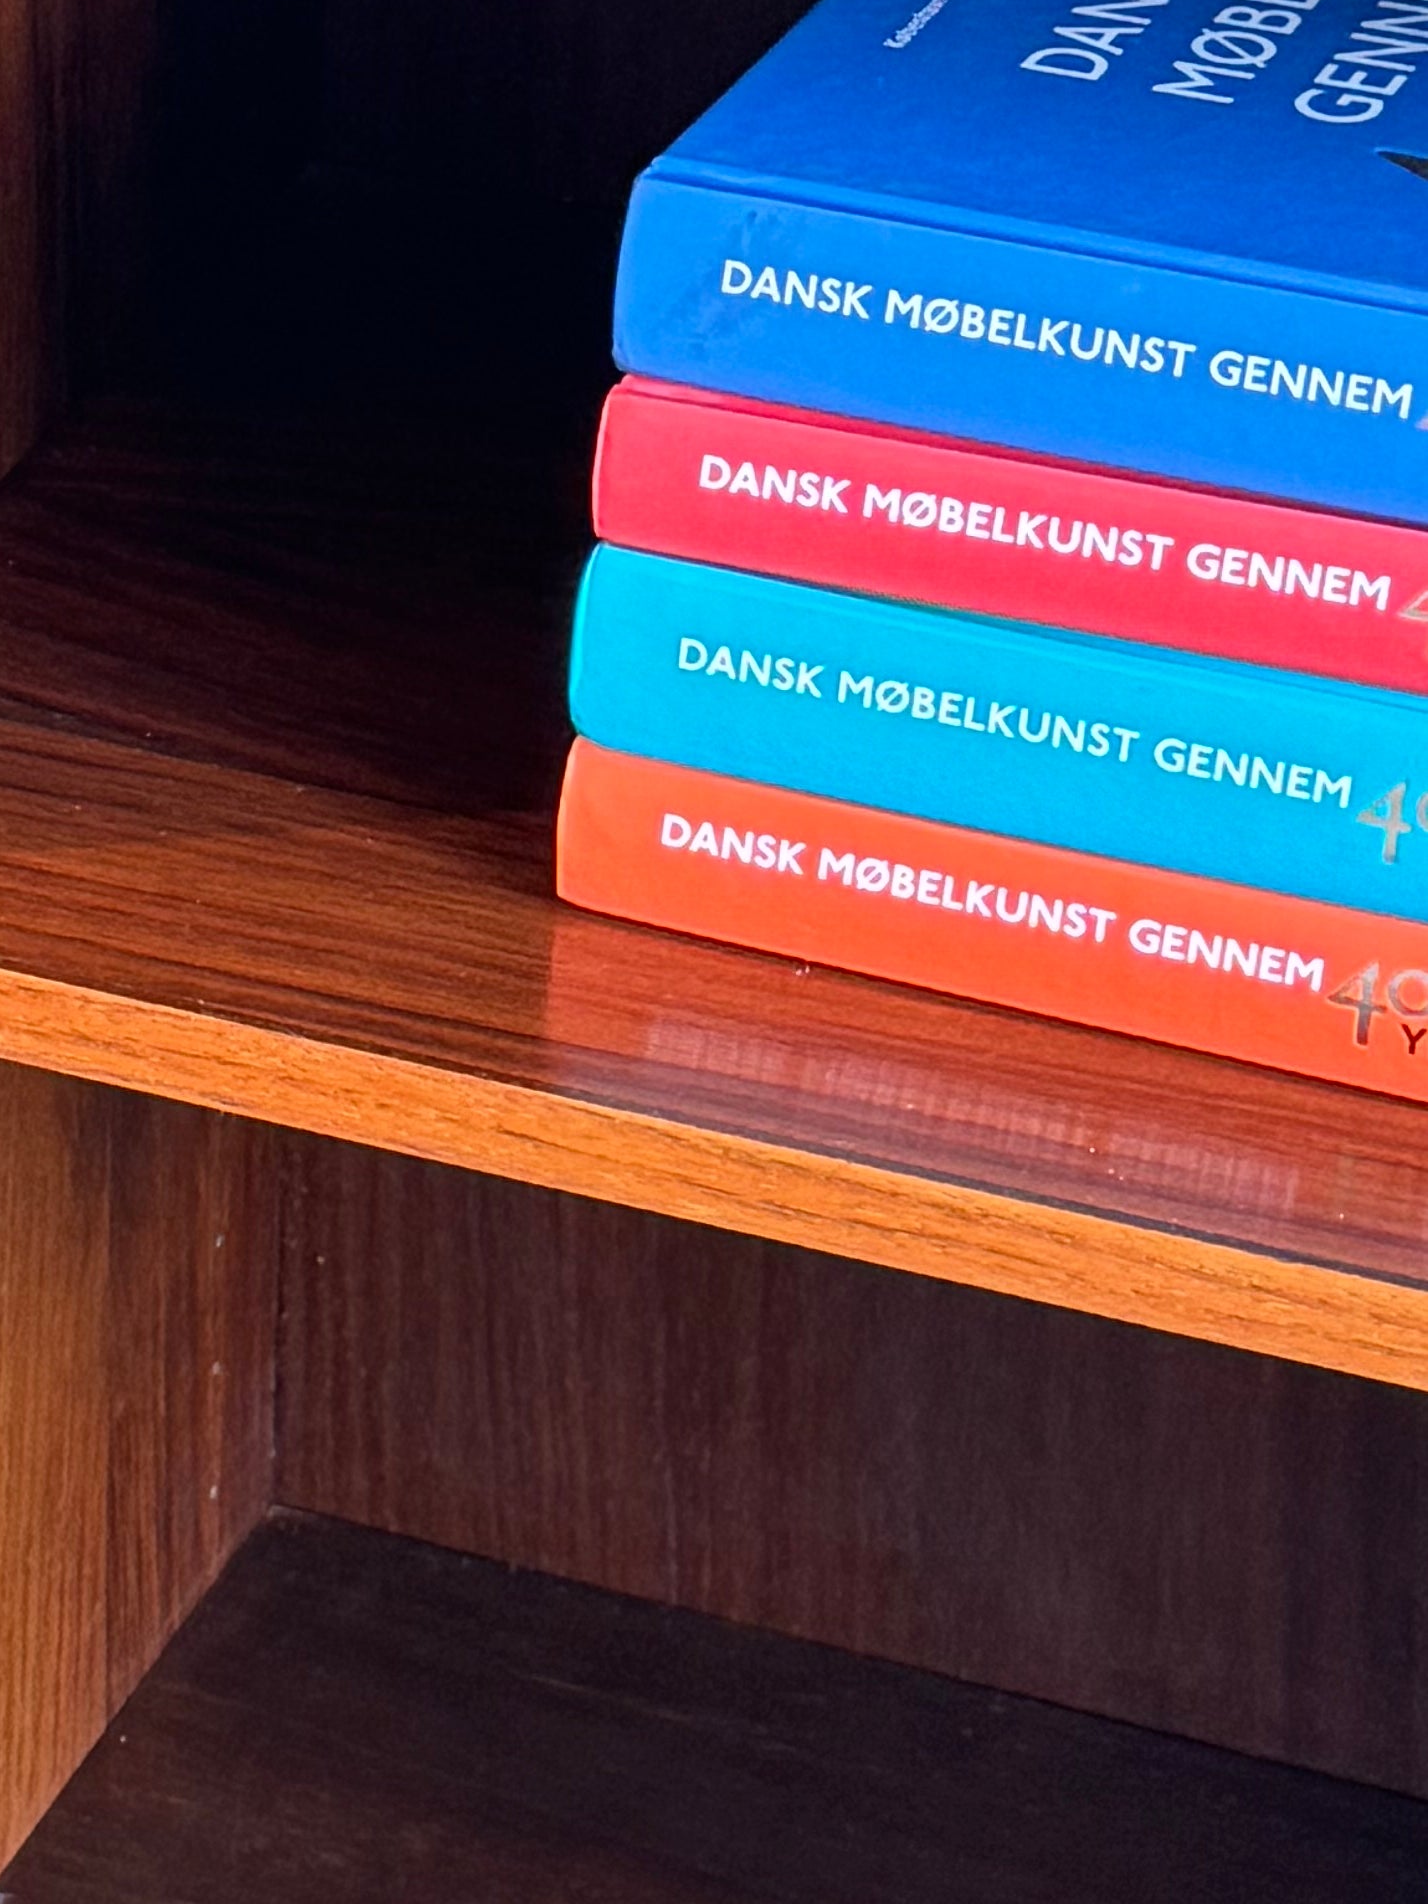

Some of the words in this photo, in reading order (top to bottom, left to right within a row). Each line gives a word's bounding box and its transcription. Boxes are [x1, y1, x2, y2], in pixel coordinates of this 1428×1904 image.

[721, 259, 871, 319] DANSK
[884, 289, 1196, 378] MØBELKUNST
[1209, 350, 1412, 419] GENNEM
[699, 454, 850, 513] DANSK
[862, 483, 1174, 571] MØBELKUNST
[1186, 543, 1391, 611] GENNEM
[677, 637, 823, 698] DANSK
[837, 670, 1140, 762] MØBELKUNST
[1153, 737, 1352, 809] GENNEM
[1355, 782, 1428, 864] 4
[660, 813, 803, 876] DANSK
[817, 847, 1117, 943] MØBELKUNST
[1128, 918, 1325, 993] GENNEM
